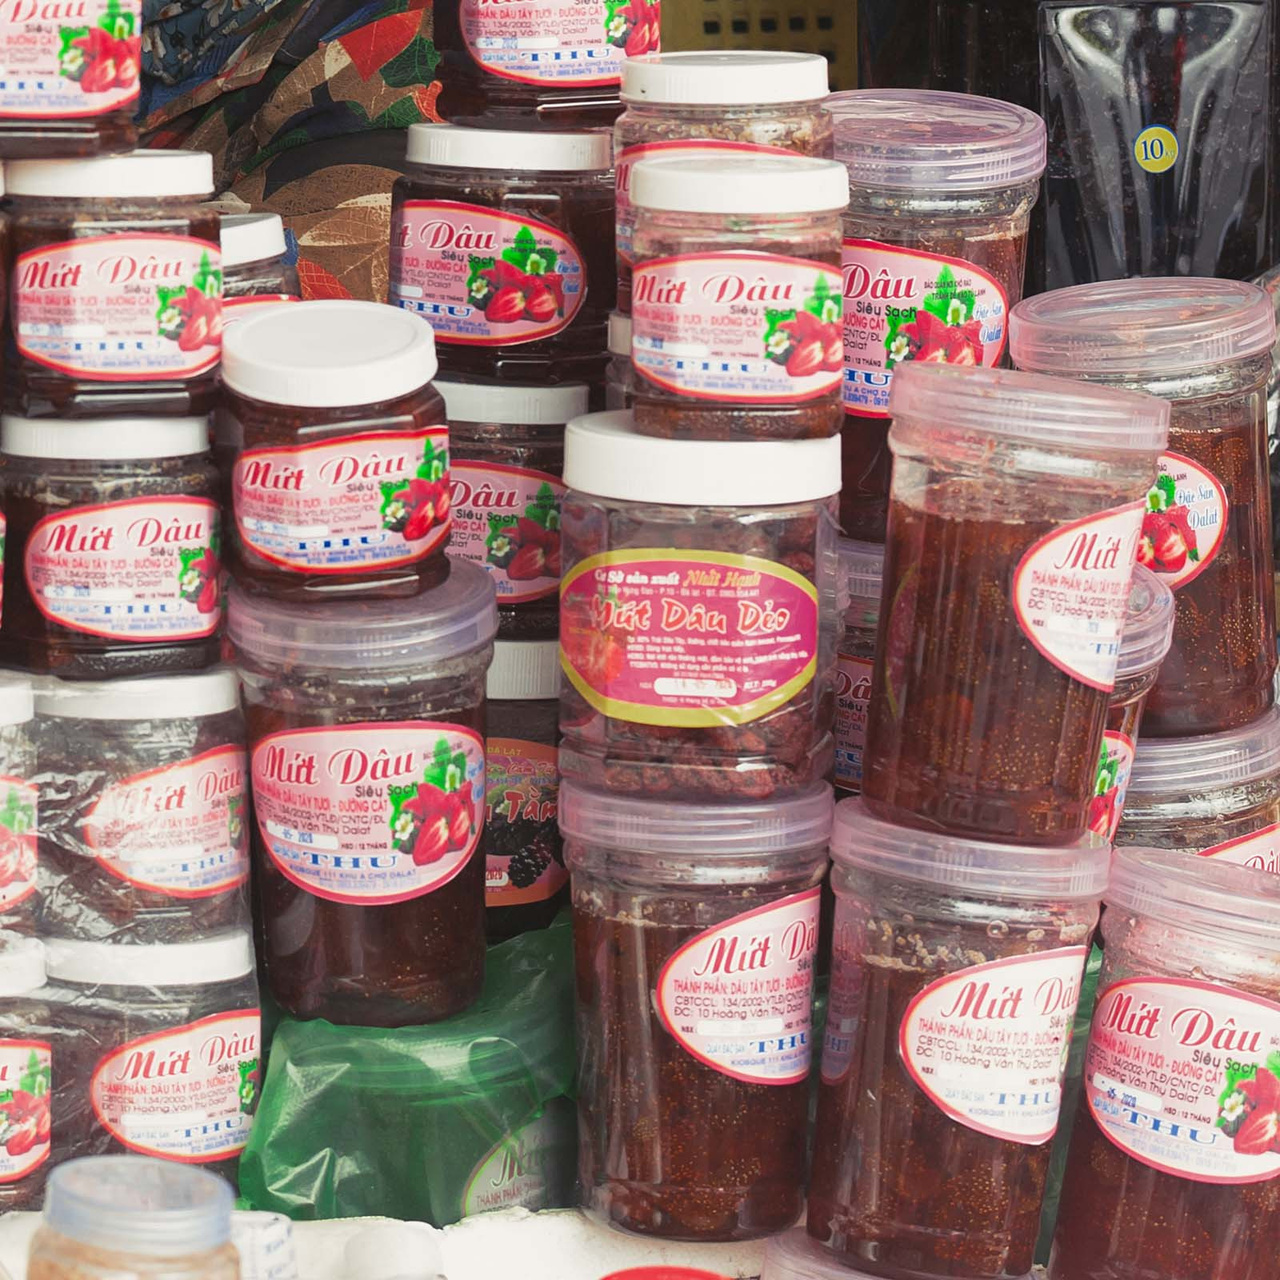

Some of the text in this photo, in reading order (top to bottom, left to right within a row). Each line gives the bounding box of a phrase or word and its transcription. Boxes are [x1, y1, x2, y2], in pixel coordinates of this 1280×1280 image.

[520, 49, 610, 61] THU
[1142, 138, 1164, 160] 10
[420, 221, 496, 250] Dâu
[441, 250, 496, 266] Siêu Sạch
[20, 256, 182, 289] Mứt Dâu
[842, 263, 917, 299] Dâu
[634, 274, 793, 304] Mứt Dâu
[856, 301, 917, 319] Siêu Sạch
[868, 318, 884, 331] CÁT
[242, 454, 406, 490] Mứt Dâu
[346, 483, 374, 493] Siêu
[450, 480, 520, 508] Dâu
[456, 509, 483, 520] Siêu
[1189, 509, 1217, 528] Dalat
[41, 517, 206, 553] Mứt Dâu
[150, 547, 174, 557] Siêu
[1054, 532, 1121, 571] Mứt
[661, 597, 790, 634] Dâu Dẻo
[839, 698, 862, 712] Siêu
[263, 745, 418, 785] Mứt Dâu
[197, 768, 242, 801] Dâu
[355, 782, 419, 798] Siêu Sạch
[343, 825, 371, 835] Dalat
[303, 851, 399, 870] THU
[693, 936, 770, 976] Mứt
[673, 977, 701, 993] THÀNH
[731, 979, 747, 995] DÂU
[941, 981, 1023, 1020] Mứt
[698, 1008, 709, 1018] 10
[712, 1008, 748, 1020] Hoàng
[750, 1008, 769, 1017] Văn
[1101, 992, 1262, 1053] Mứt Dâu
[115, 1032, 256, 1081] Mứt Dâu
[941, 1050, 951, 1061] 10
[955, 1054, 990, 1068] Hoàng
[1192, 1050, 1259, 1076] Siêu Sạch
[217, 1064, 236, 1075] Siêu
[1169, 1089, 1198, 1104] Dalat
[1122, 1108, 1217, 1145] THU
